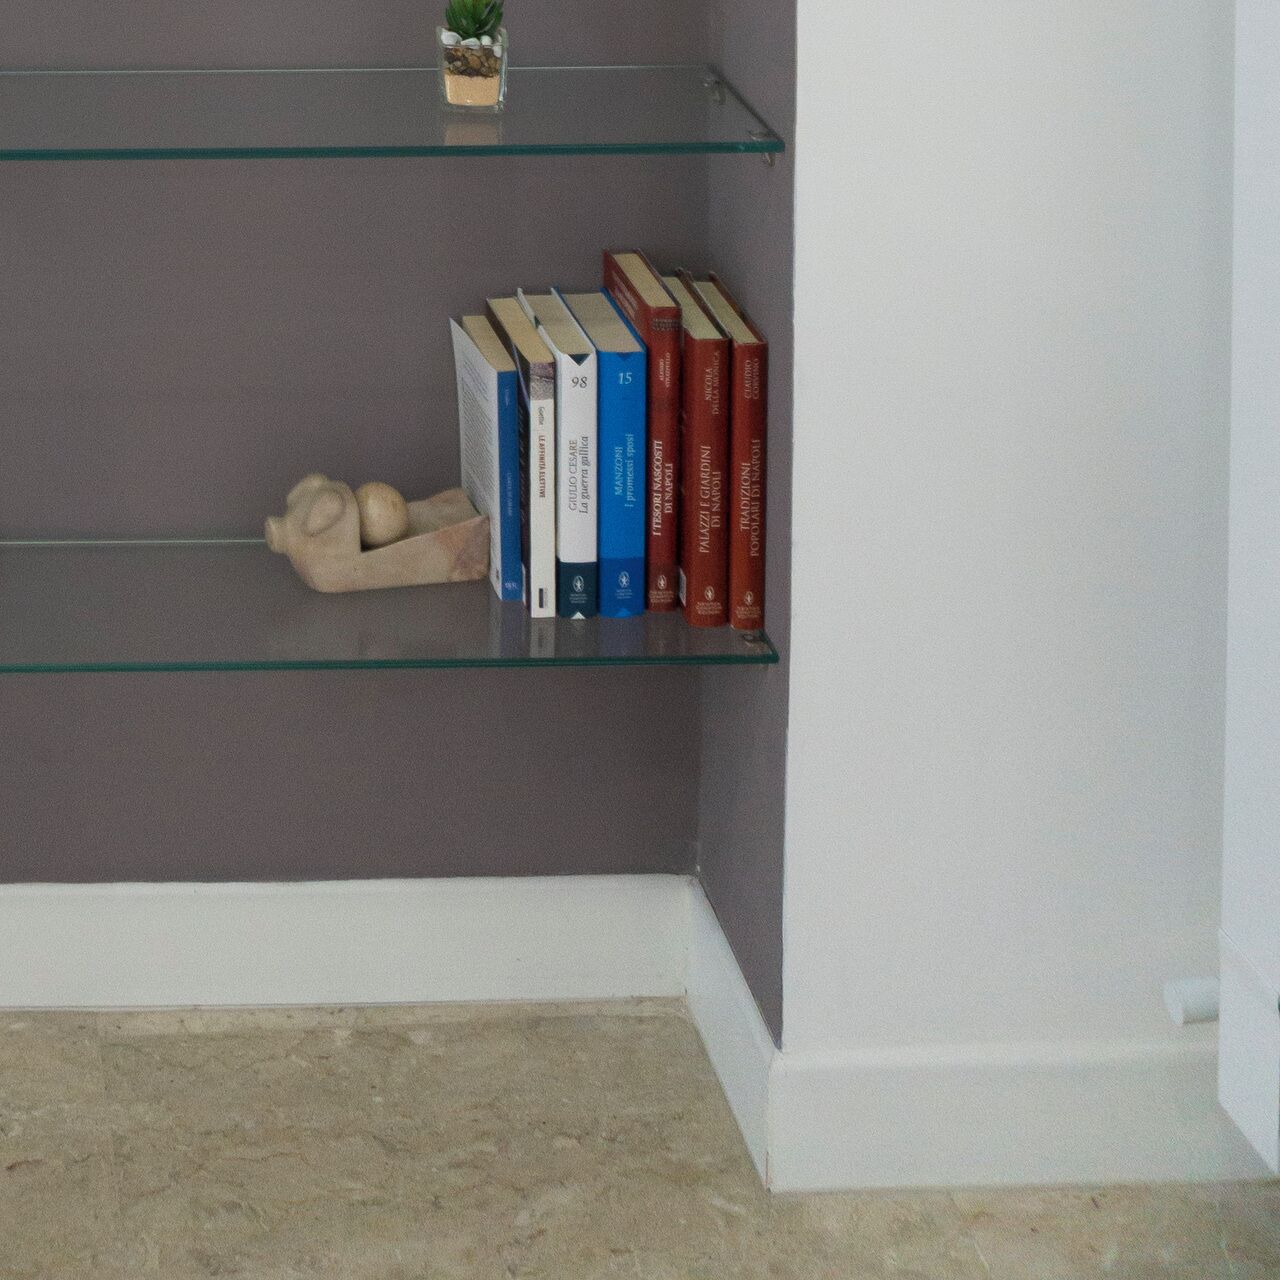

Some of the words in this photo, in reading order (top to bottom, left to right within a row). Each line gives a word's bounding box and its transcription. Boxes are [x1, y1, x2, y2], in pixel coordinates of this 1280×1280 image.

[571, 376, 588, 388] 98
[618, 371, 633, 385] 15
[704, 367, 713, 401] NICOLA
[712, 351, 720, 386] MONICA
[744, 359, 752, 399] CLAUDIO
[752, 358, 760, 399] CORVINO
[712, 389, 720, 415] DELLA
[538, 434, 545, 442] LE
[578, 435, 589, 467] gallica
[624, 433, 635, 458] sposi
[568, 439, 577, 474] CESARE
[614, 446, 624, 496] MANZONI
[652, 439, 663, 491] NASCOSTI
[700, 444, 711, 499] GIARDINI
[750, 439, 761, 481] NAPOLI
[568, 476, 577, 511] GIULIO
[578, 469, 590, 500] guerra
[624, 460, 636, 501] promessi
[664, 462, 673, 500] NAPOLI
[712, 471, 721, 512] NAPOLI
[740, 462, 751, 532] TRADIZIONI
[750, 484, 760, 498] DI
[578, 501, 589, 514] La
[652, 492, 662, 529] TESORI
[664, 501, 673, 514] DI
[700, 500, 711, 508] E
[712, 515, 721, 528] DI
[700, 510, 711, 553] PALAZZI
[750, 500, 761, 557] POPOLARI
